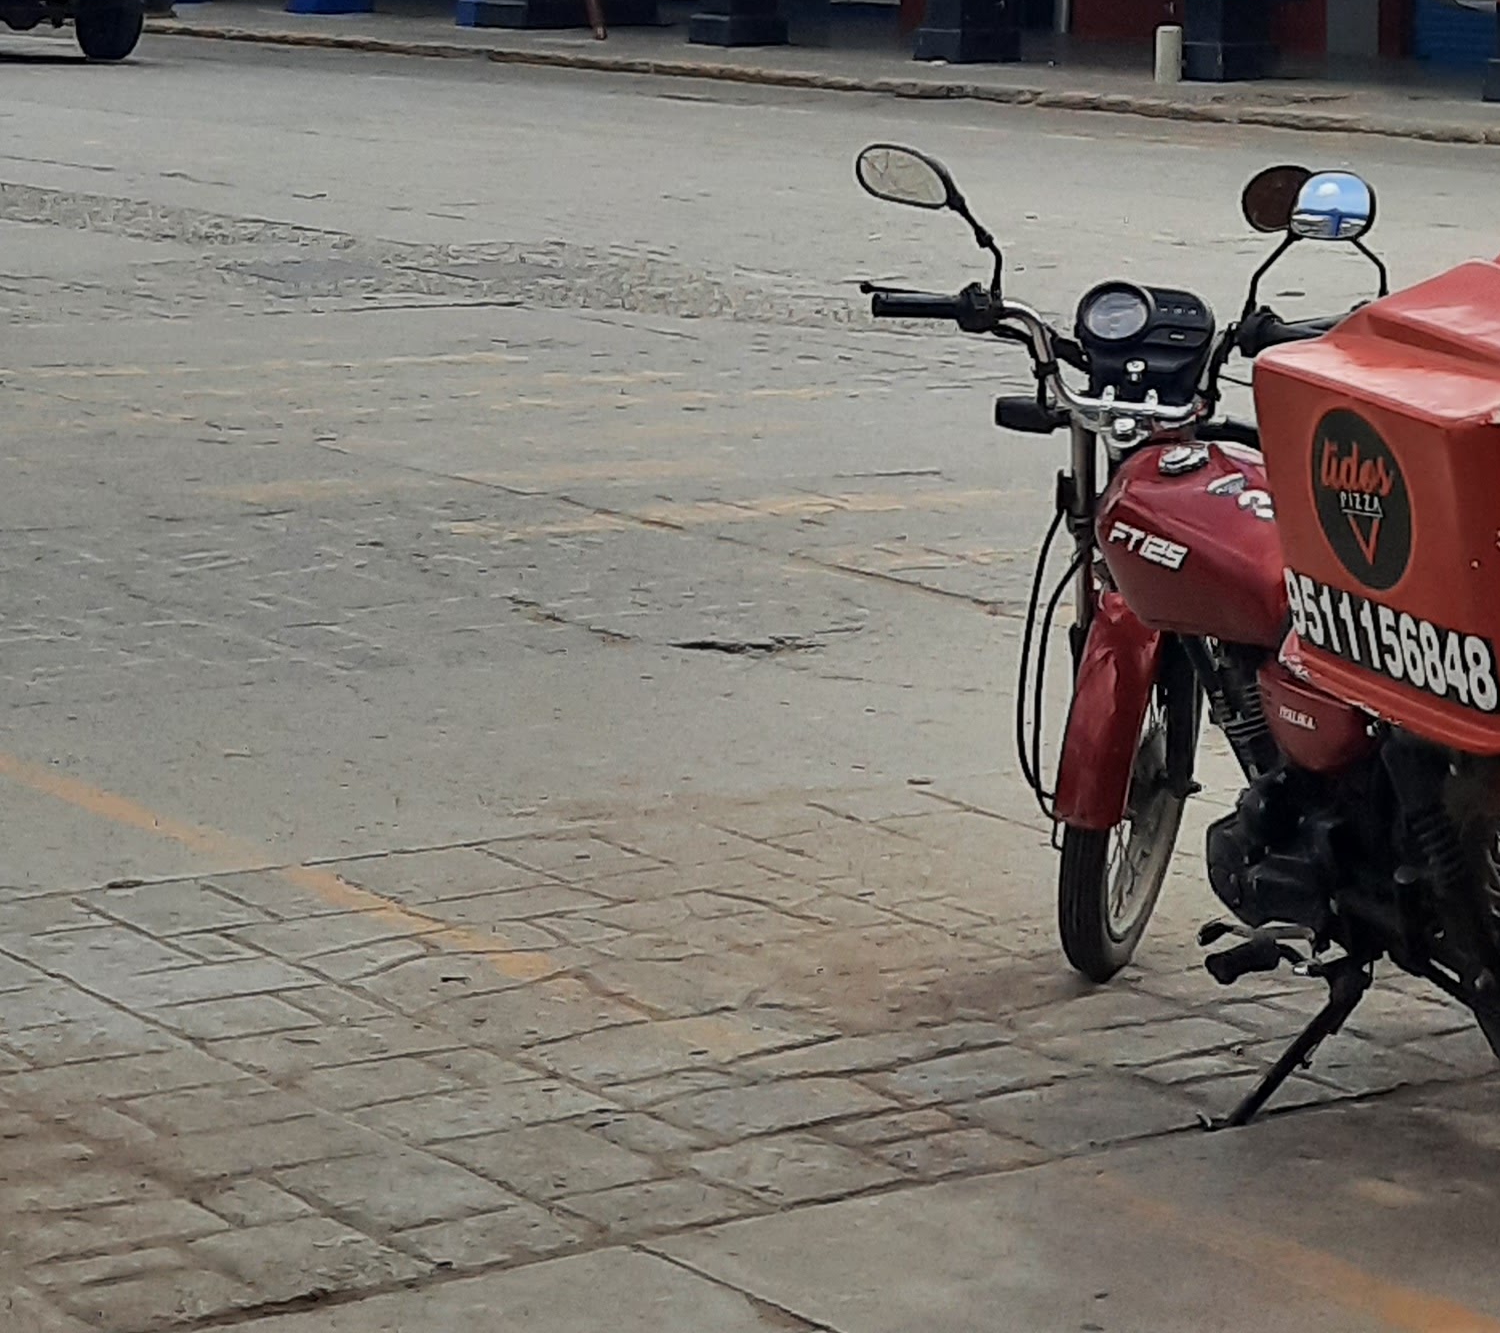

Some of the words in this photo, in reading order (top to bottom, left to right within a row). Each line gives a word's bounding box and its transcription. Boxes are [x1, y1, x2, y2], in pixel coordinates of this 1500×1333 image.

[1339, 491, 1382, 515] PIZZA
[1107, 521, 1190, 571] FT125
[1283, 567, 1497, 711] 9511156848
